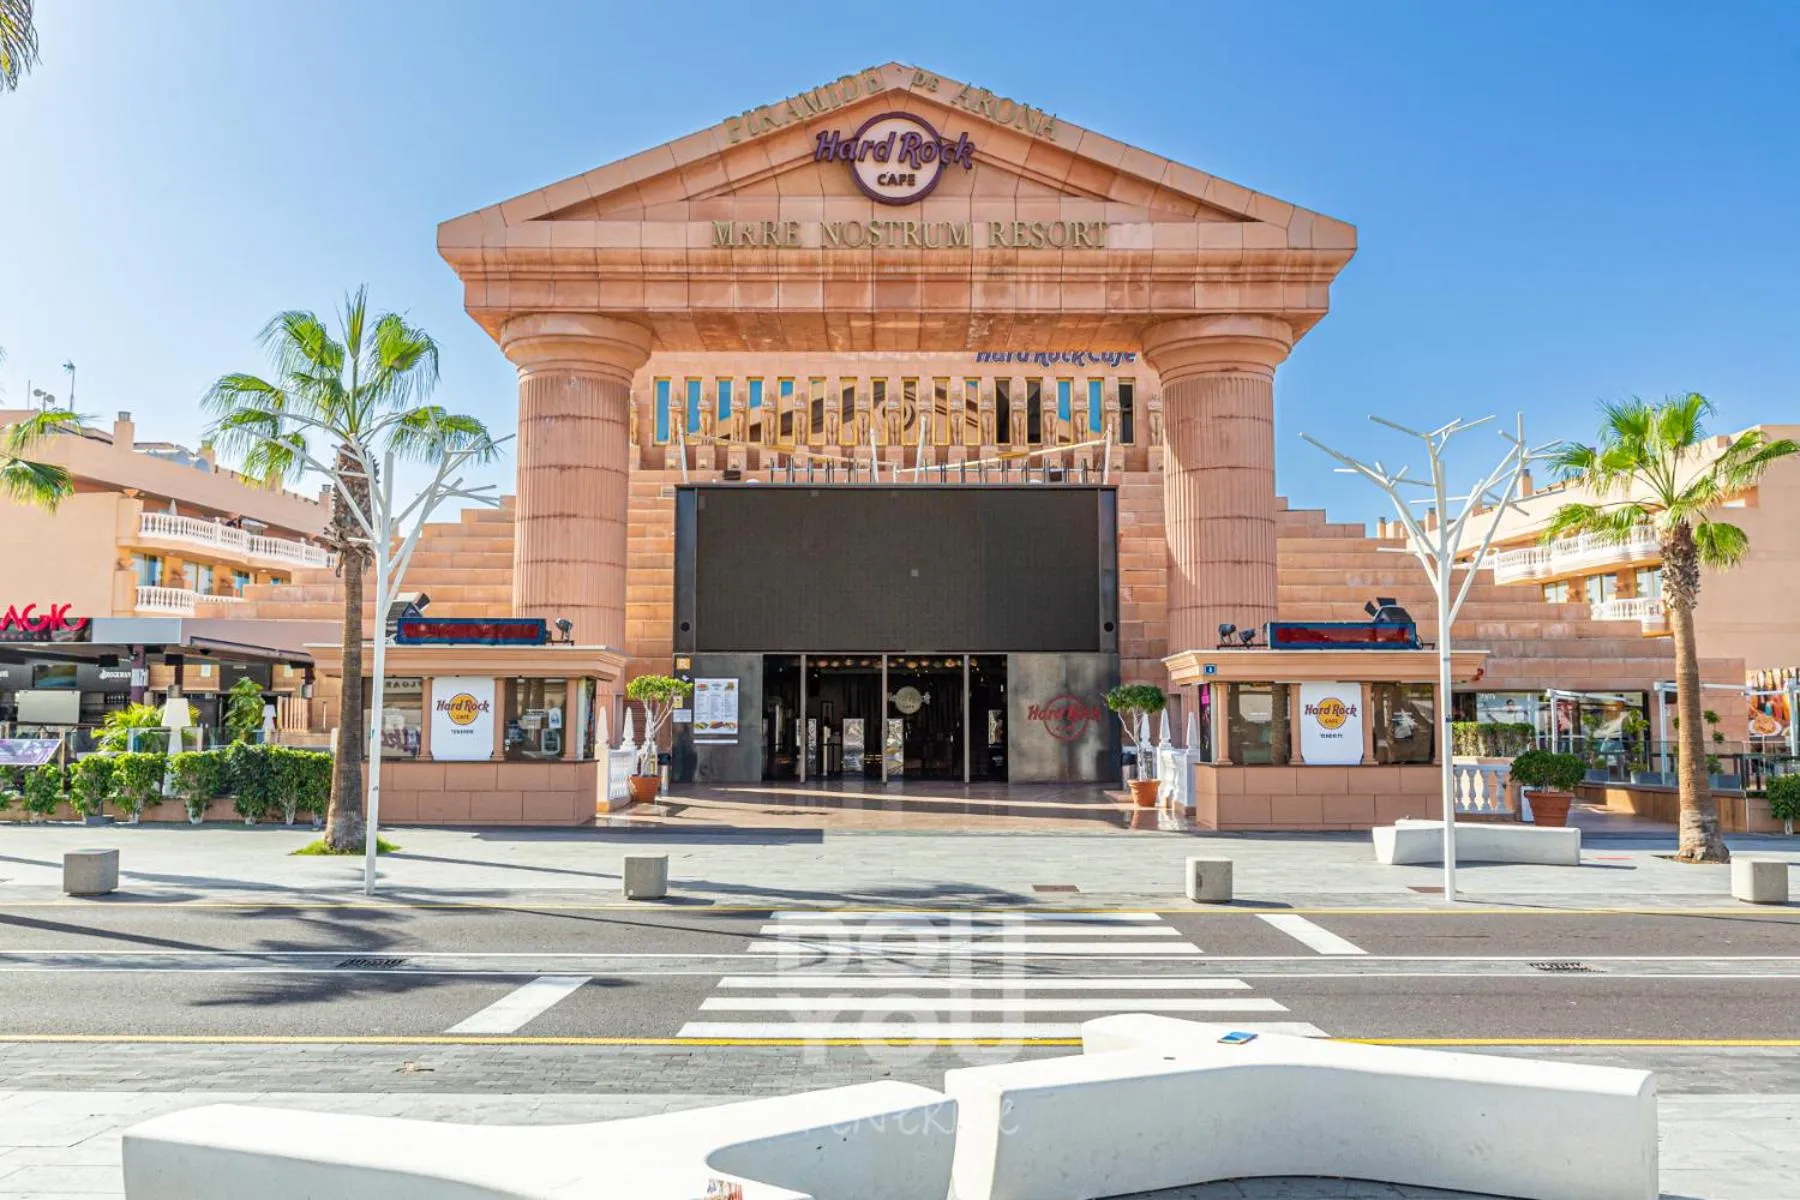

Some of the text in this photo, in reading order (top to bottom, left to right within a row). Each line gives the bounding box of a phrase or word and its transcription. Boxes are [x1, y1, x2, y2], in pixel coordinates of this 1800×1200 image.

[911, 71, 940, 93] DE
[814, 130, 975, 170] Hard Rock
[876, 173, 916, 187] CAFE
[820, 220, 972, 249] NOSTRUM
[988, 220, 1107, 249] RESORT
[436, 699, 490, 713] Hard Rock
[1304, 703, 1357, 718] Hard Rock
